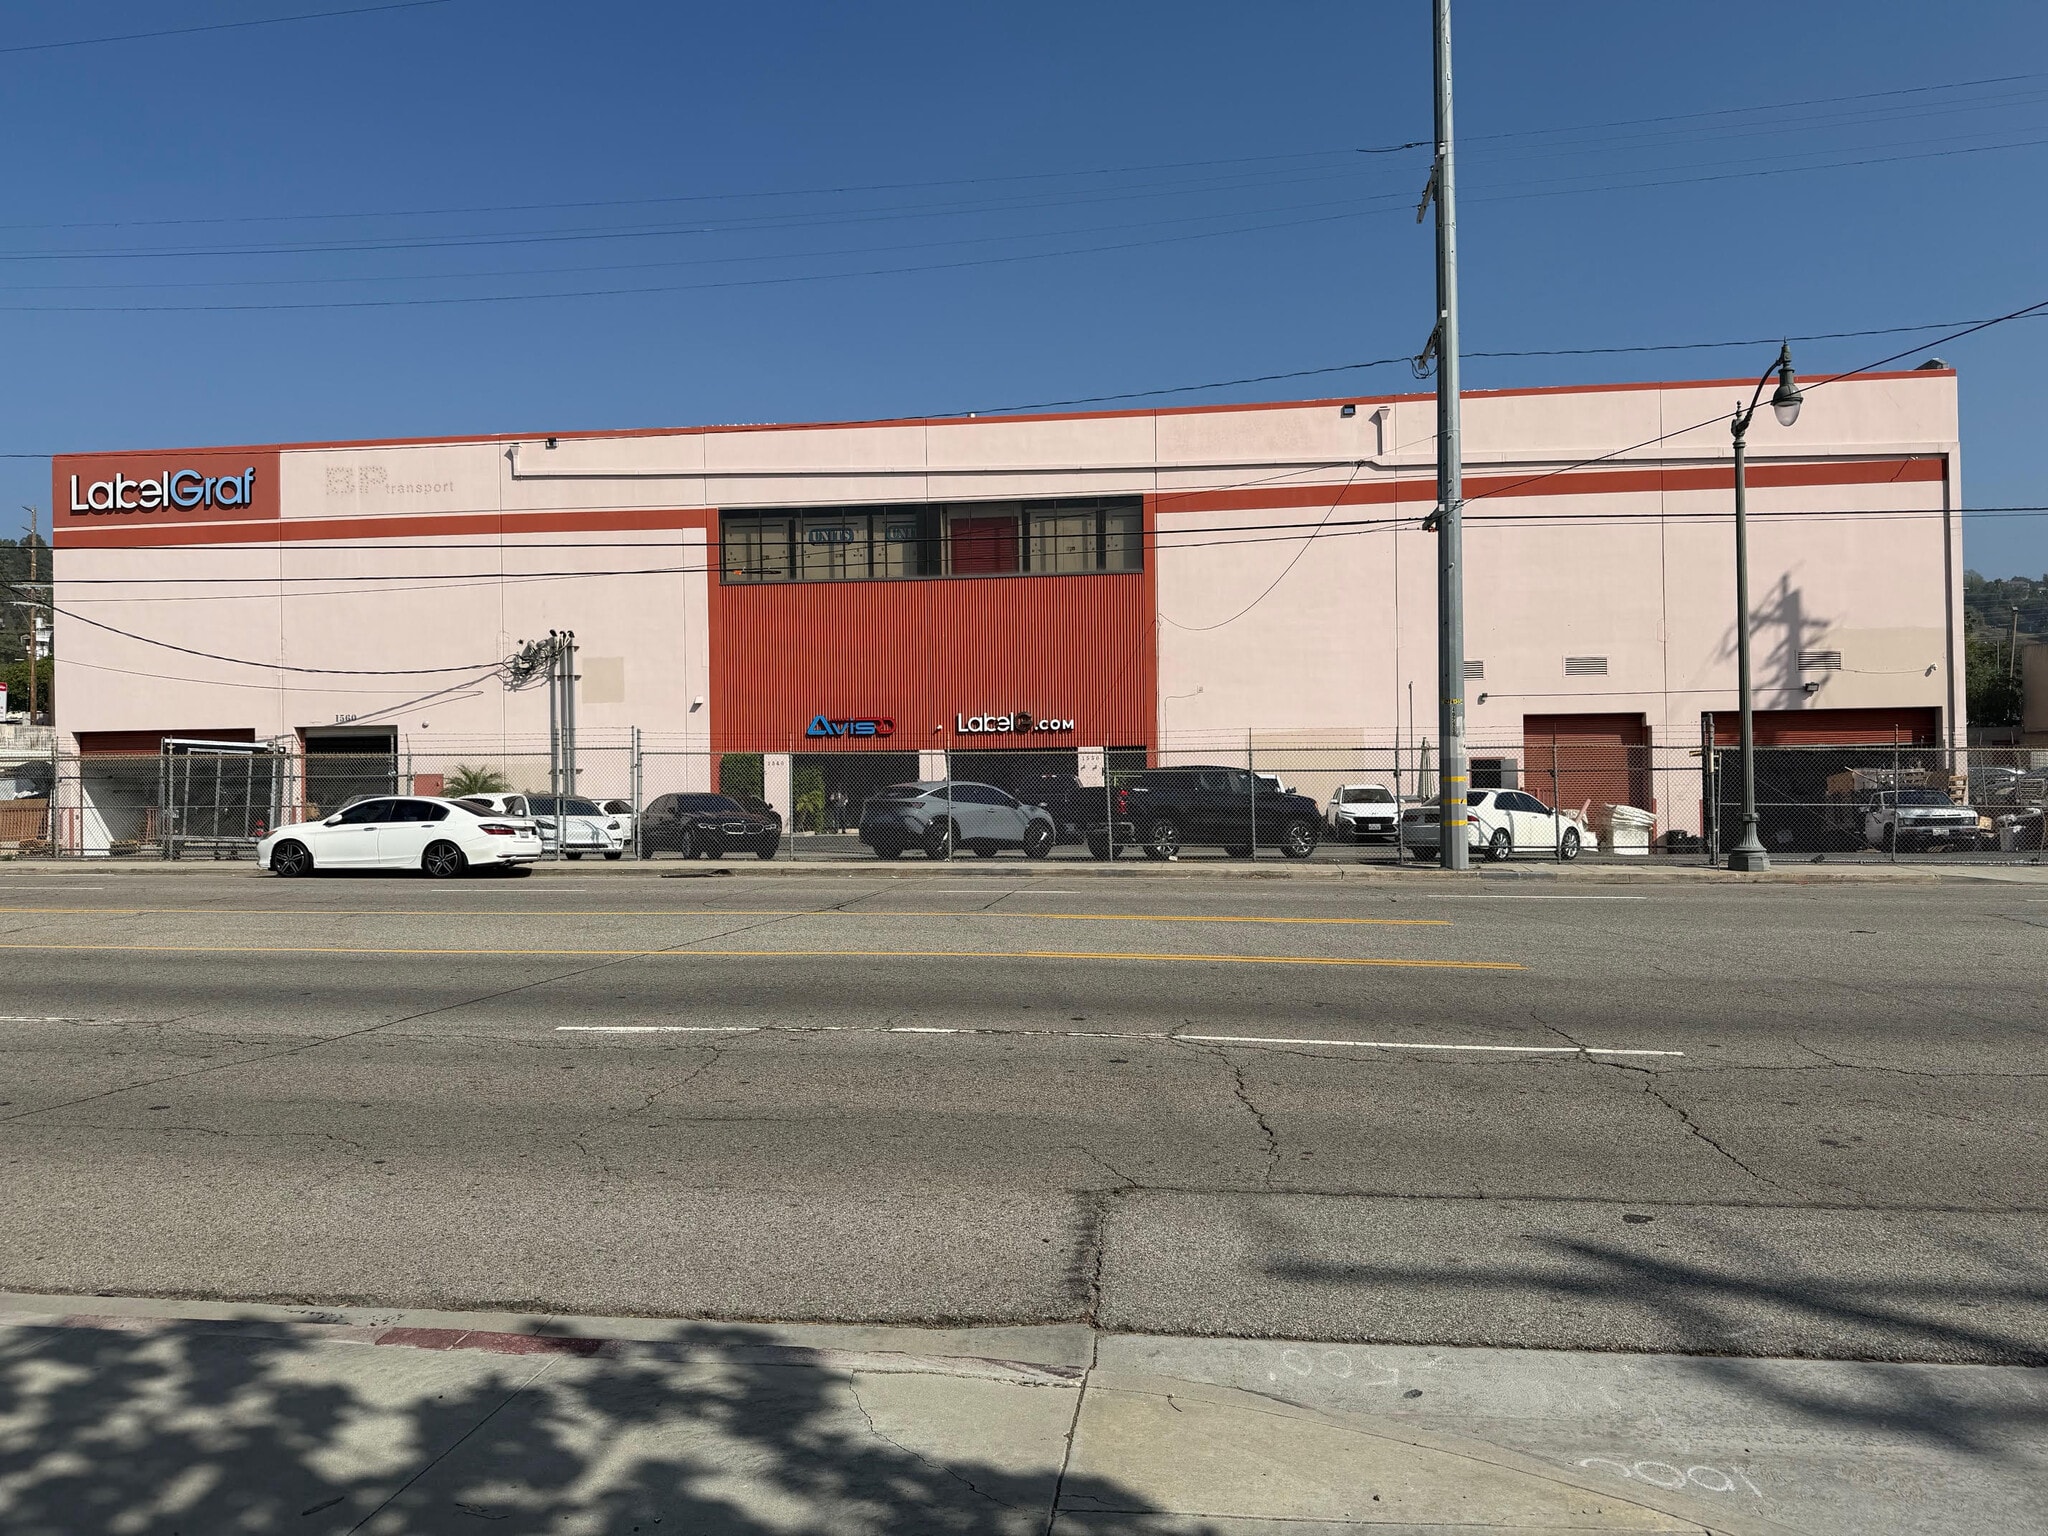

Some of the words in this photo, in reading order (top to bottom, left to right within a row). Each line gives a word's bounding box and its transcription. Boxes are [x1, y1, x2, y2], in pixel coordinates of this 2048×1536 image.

[70, 466, 255, 512] LabelGraf
[385, 481, 454, 495] transport
[811, 529, 852, 541] UNITS
